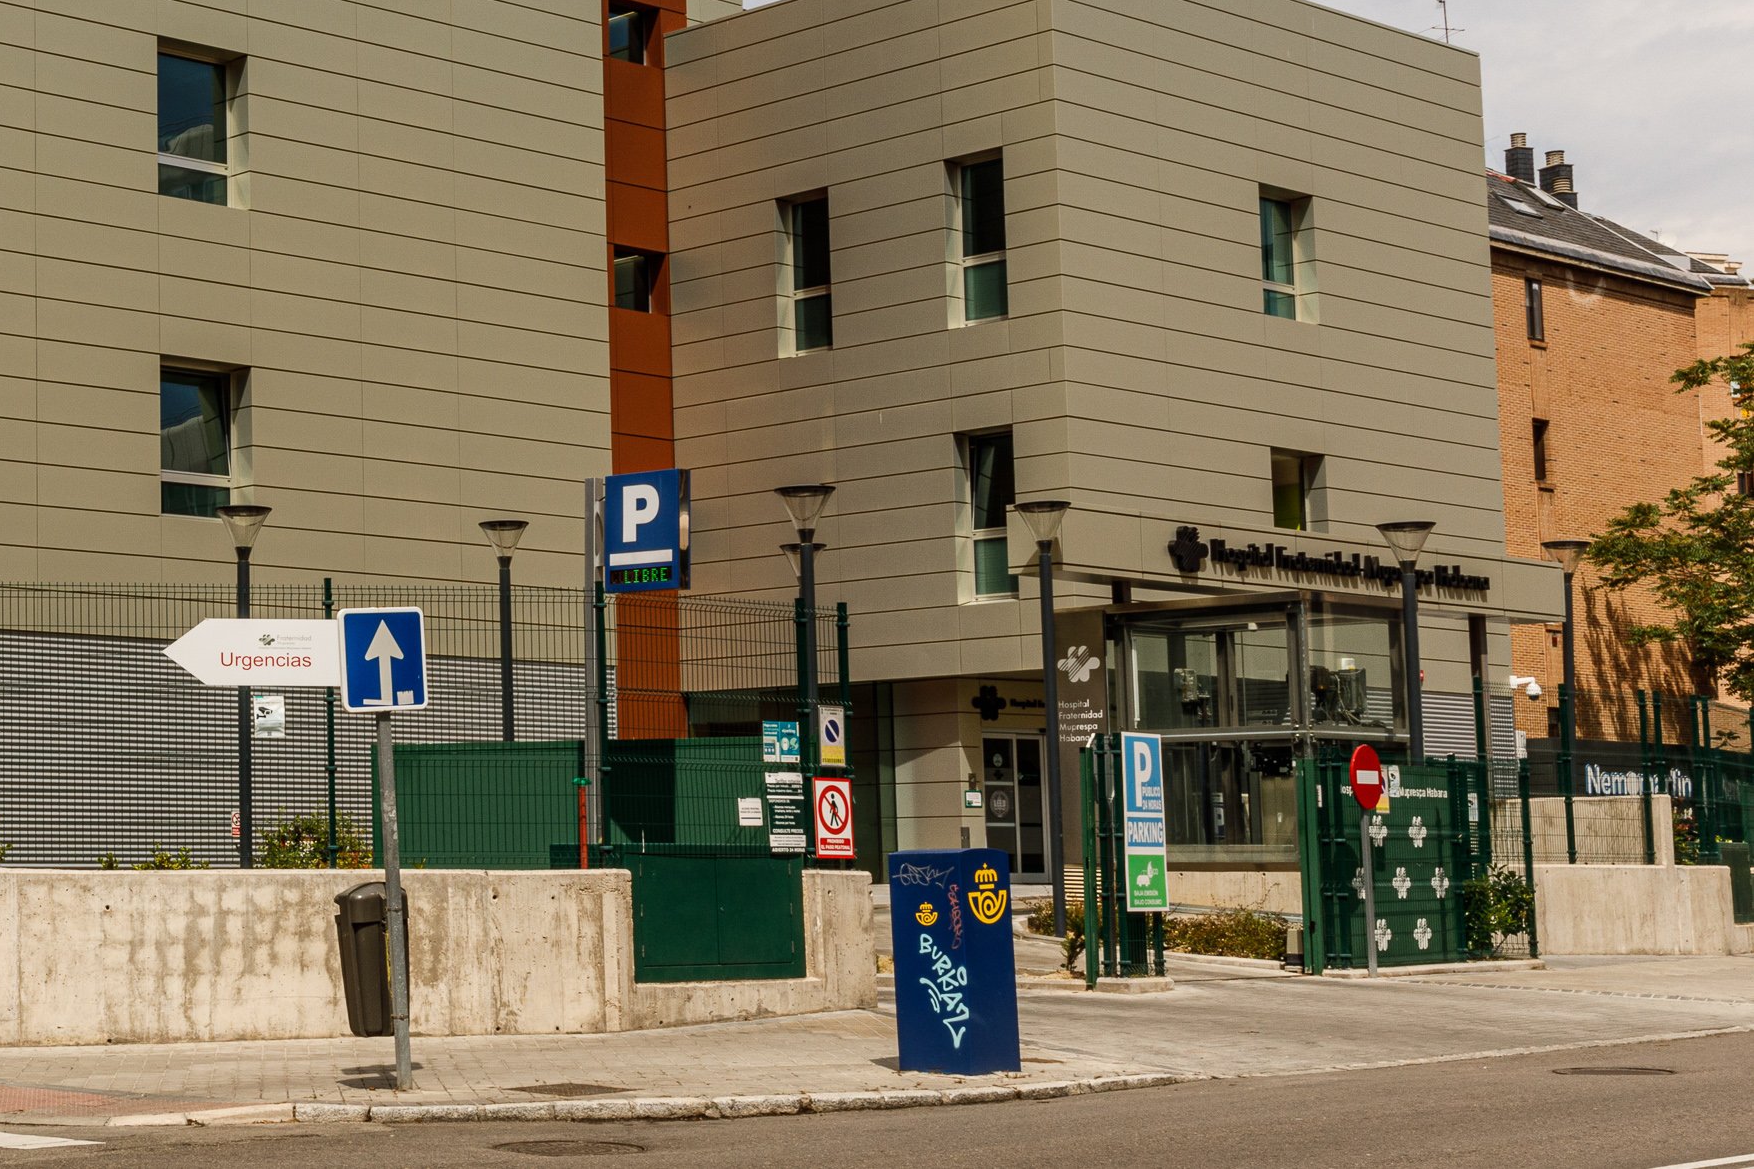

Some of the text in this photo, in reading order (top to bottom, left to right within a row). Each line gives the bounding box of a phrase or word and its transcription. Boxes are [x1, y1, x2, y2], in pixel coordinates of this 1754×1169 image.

[622, 483, 660, 543] P
[624, 567, 668, 584] LIBRE
[220, 652, 312, 671] Urgencias
[1058, 699, 1090, 710] Hospital
[1058, 710, 1103, 720] Fraternidad
[1059, 723, 1098, 733] Muprespa
[1133, 741, 1152, 807] P
[1128, 821, 1163, 843] PARKING
